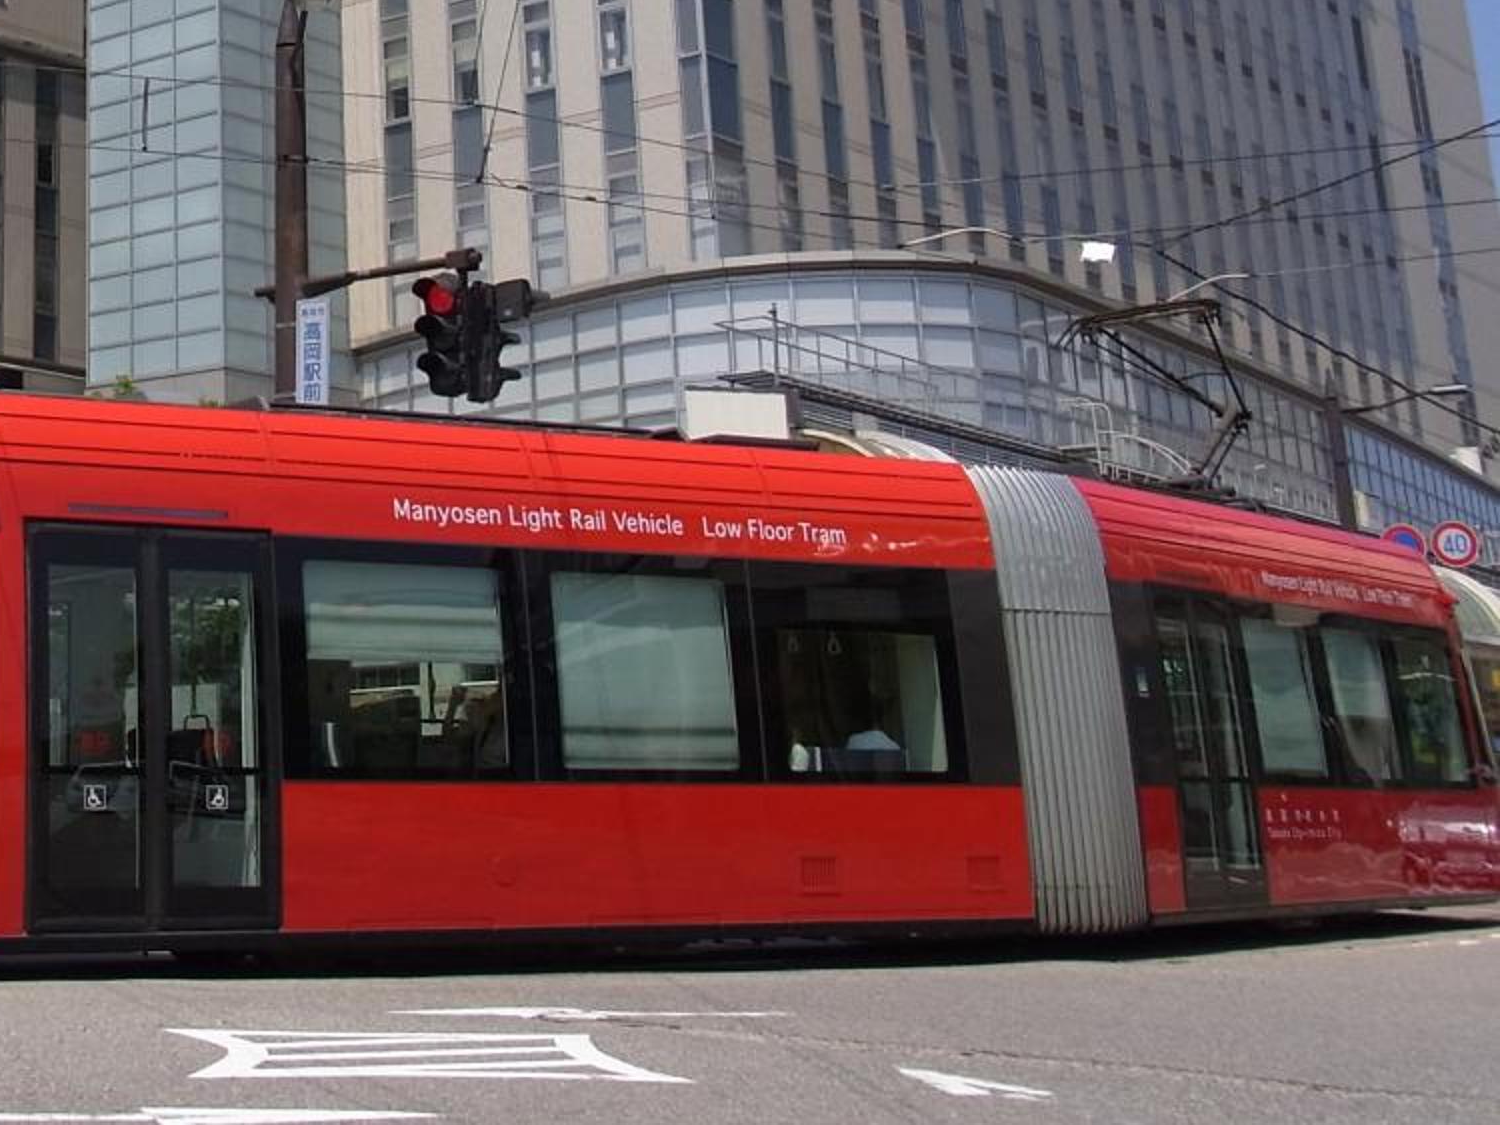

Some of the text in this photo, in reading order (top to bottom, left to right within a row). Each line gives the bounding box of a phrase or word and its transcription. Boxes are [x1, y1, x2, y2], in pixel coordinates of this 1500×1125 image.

[303, 322, 321, 402] 高岡駅前
[393, 497, 847, 547] Manyosen Light Rail Vehicle Low Floor Tram
[1443, 534, 1468, 555] 40
